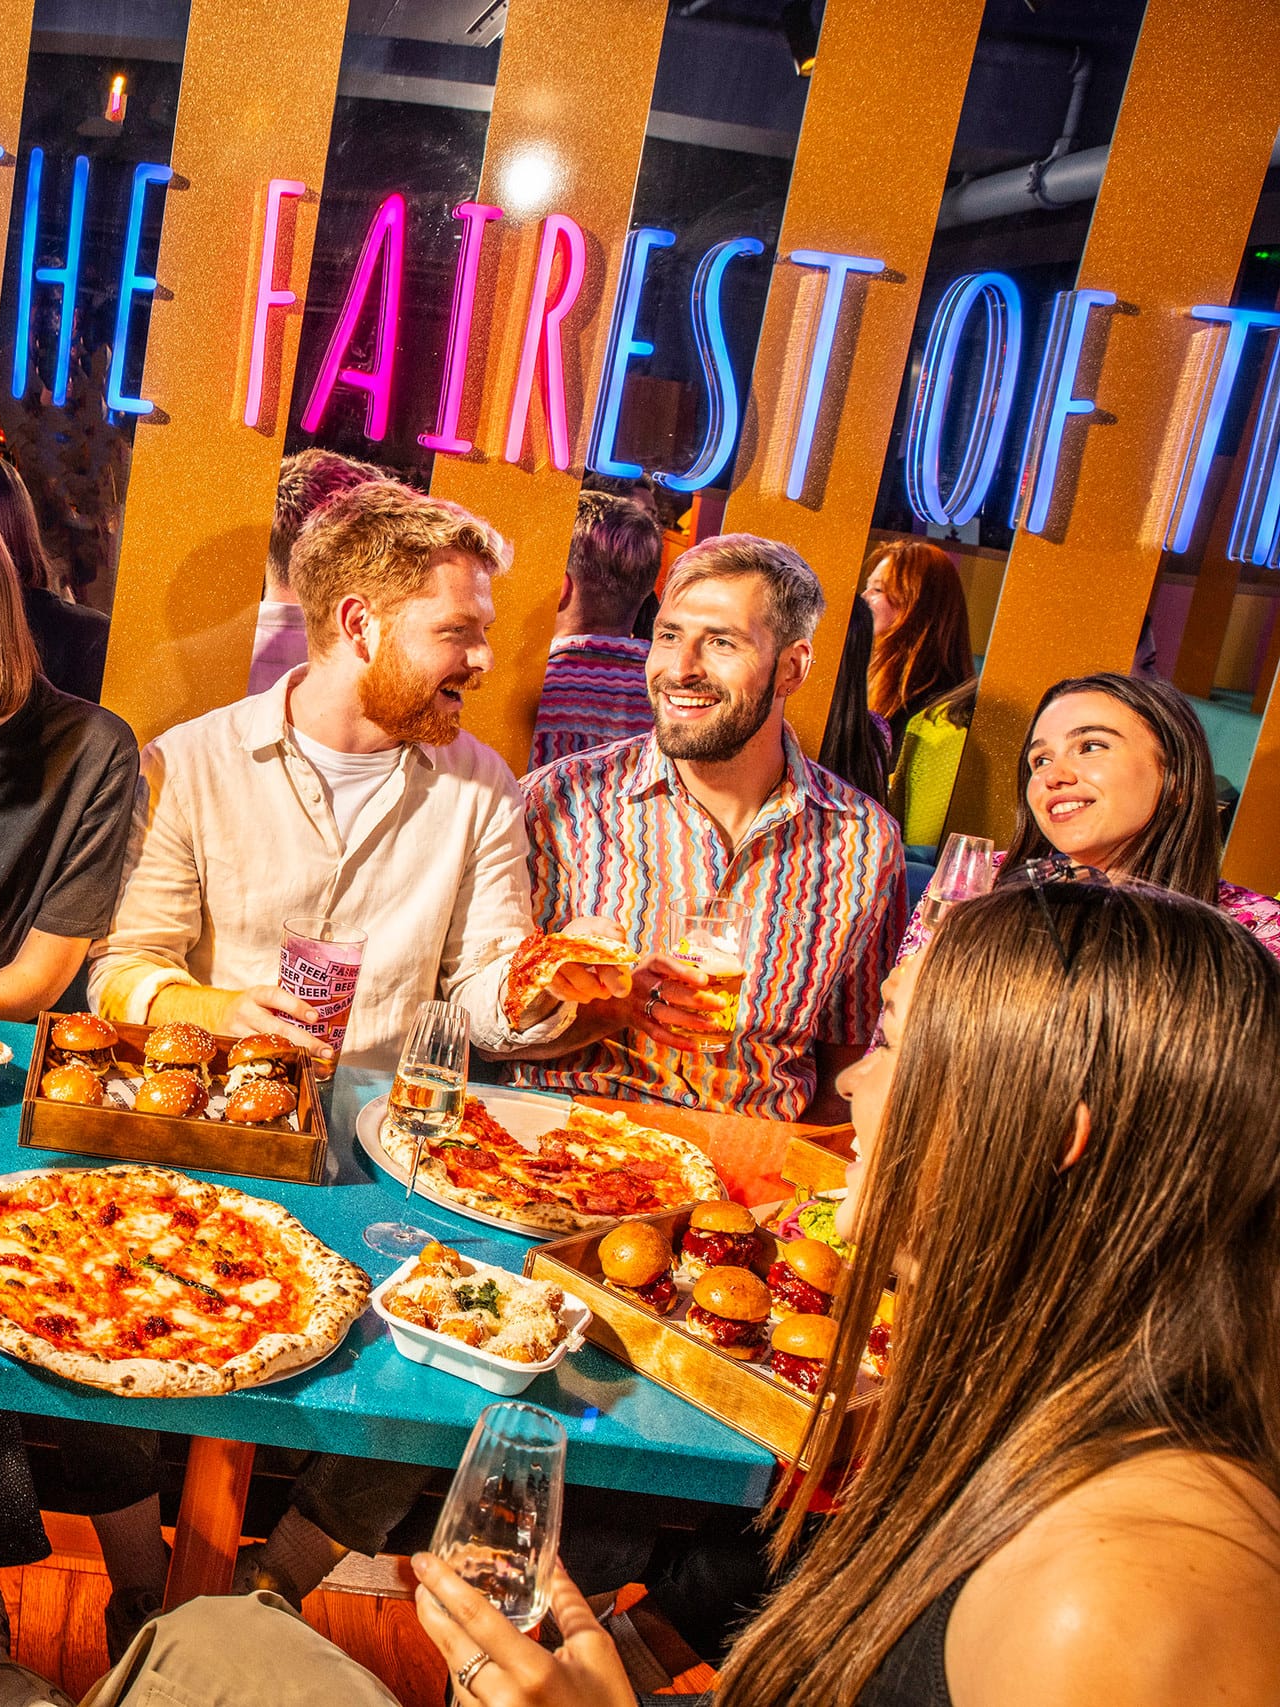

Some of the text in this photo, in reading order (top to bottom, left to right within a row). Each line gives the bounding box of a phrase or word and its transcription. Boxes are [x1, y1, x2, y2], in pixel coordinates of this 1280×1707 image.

[243, 179, 885, 501] FAIREST
[906, 271, 1117, 534] OF
[299, 962, 329, 982] BEER
[299, 986, 327, 998] BEER
[332, 1028, 346, 1038] BE
